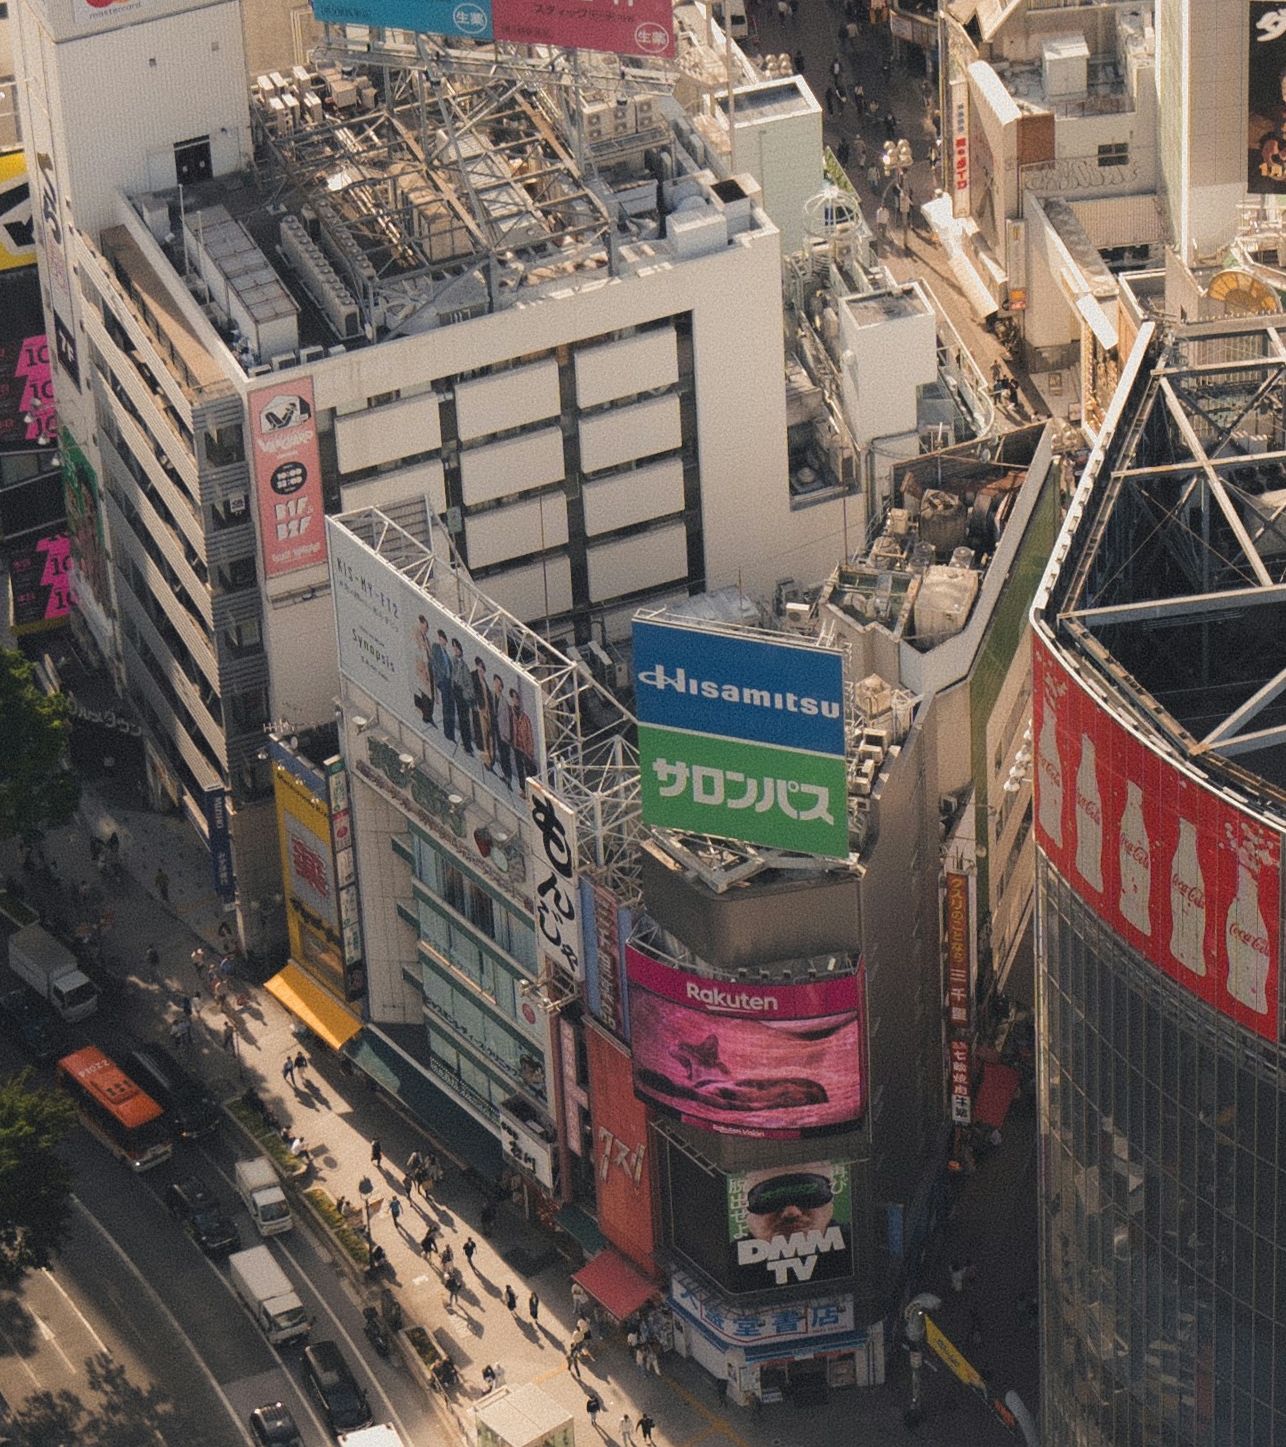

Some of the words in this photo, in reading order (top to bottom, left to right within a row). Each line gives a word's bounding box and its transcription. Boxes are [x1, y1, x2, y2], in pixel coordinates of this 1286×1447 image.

[89, 1, 142, 20] mastercard
[637, 665, 840, 719] Hisamitsu
[652, 758, 835, 826] サロンパス
[531, 793, 580, 973] もんじゃ
[686, 982, 779, 1011] Rakuten
[728, 1177, 751, 1240] 脱出せよ
[737, 1226, 846, 1266] DMM
[766, 1255, 818, 1285] TV
